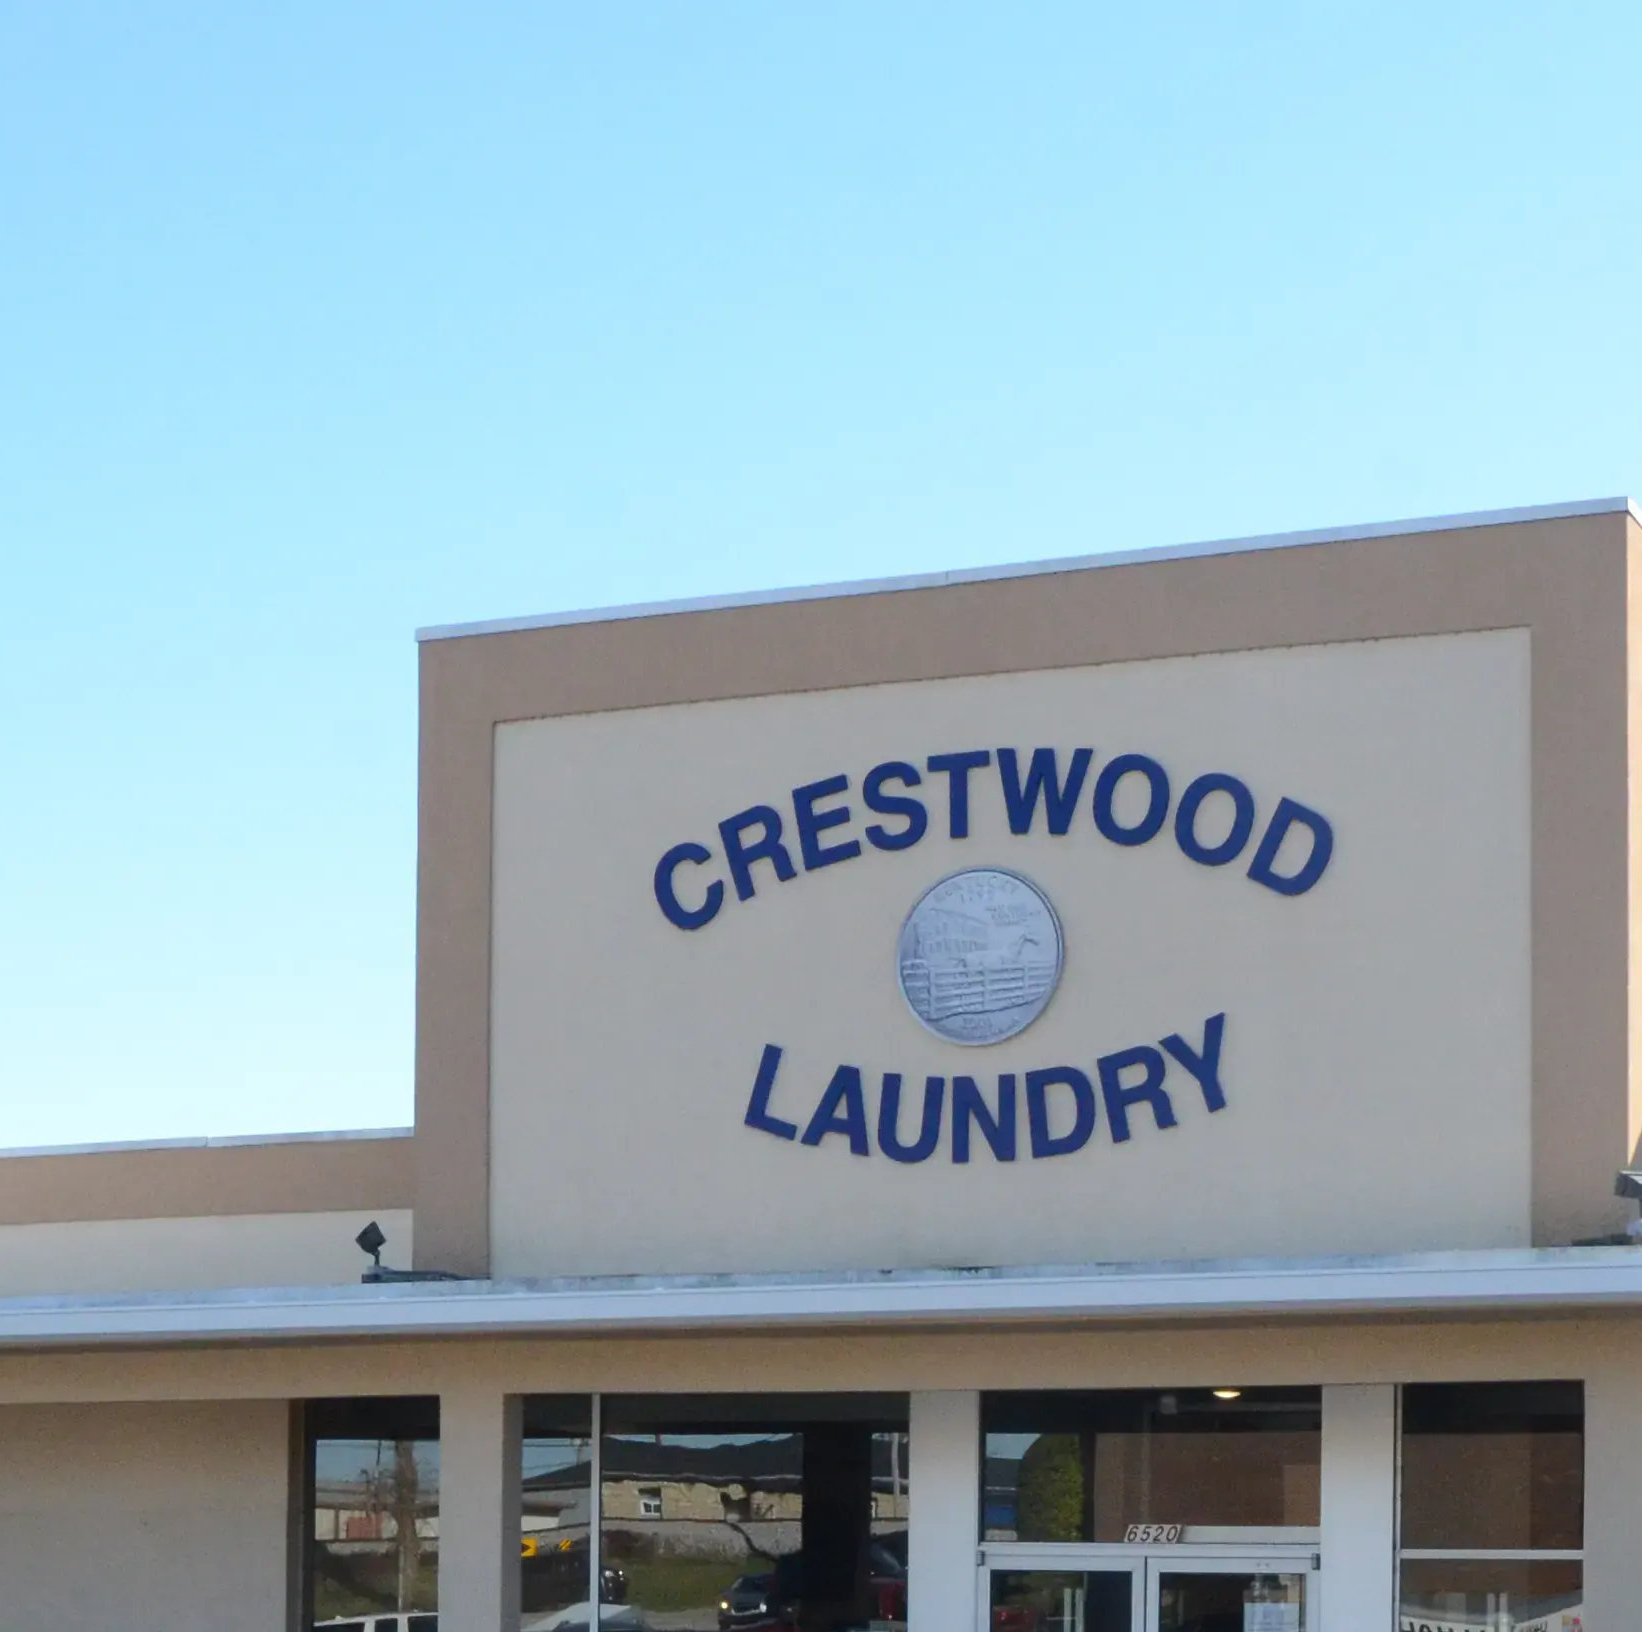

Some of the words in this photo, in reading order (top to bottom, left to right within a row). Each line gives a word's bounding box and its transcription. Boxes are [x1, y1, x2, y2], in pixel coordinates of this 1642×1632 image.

[652, 747, 1336, 932] CRESTWOOD
[743, 1011, 1230, 1164] LAUNDRY
[1127, 1525, 1178, 1542] 6520
